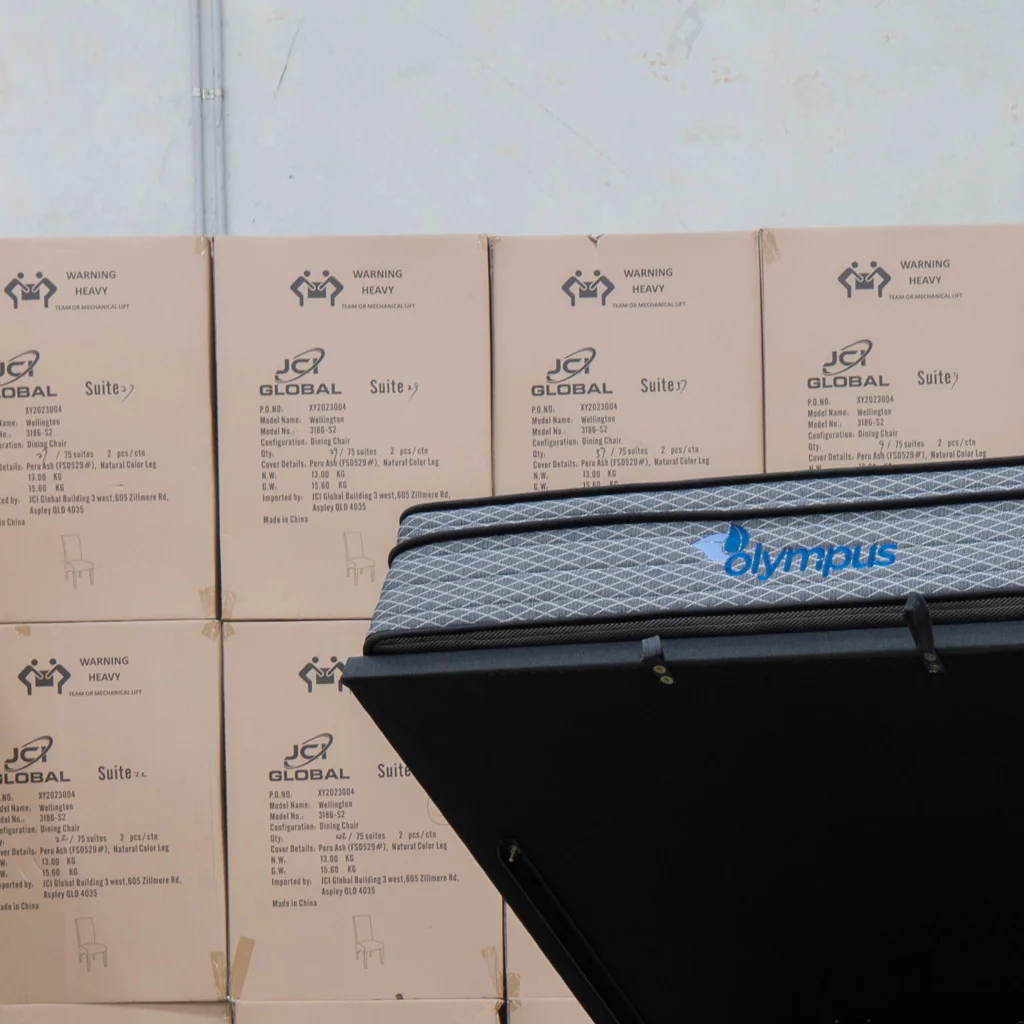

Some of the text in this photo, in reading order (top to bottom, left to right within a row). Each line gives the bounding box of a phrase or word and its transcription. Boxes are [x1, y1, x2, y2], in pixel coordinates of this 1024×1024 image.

[900, 260, 950, 269] WARNING
[66, 270, 116, 280] WARNING
[353, 269, 403, 279] WARNING
[623, 268, 673, 278] WARNING
[909, 275, 942, 285] HEAVY
[75, 286, 108, 296] HEAVY
[361, 285, 395, 294] HEAVY
[632, 284, 665, 293] HEAVY
[822, 345, 869, 370] JCI
[275, 353, 321, 378] JCI
[546, 353, 592, 378] JCI
[806, 375, 890, 389] GLOBAL
[917, 370, 951, 385] Suite
[85, 380, 119, 396] Suite
[259, 383, 342, 397] GLOBAL
[370, 379, 403, 394] Suite
[530, 382, 613, 397] GLOBAL
[640, 378, 674, 393] Suite
[581, 403, 618, 412] XY2023004
[857, 408, 892, 417] Wellington
[310, 416, 345, 425] Wellington
[581, 415, 615, 424] Wellington
[858, 429, 898, 439] Dining Chair
[311, 437, 350, 446] Dining Chair
[582, 437, 622, 446] Dining Chair
[263, 516, 280, 524] Made
[289, 515, 308, 523] China
[79, 657, 129, 666] WARNING
[88, 672, 122, 681] HEAVY
[3, 742, 50, 766] JCI
[283, 739, 329, 764] JCI
[98, 765, 132, 780] Suite
[268, 768, 350, 782] GLOBAL
[377, 763, 411, 778] Suite
[38, 791, 75, 800] XY2023004
[318, 788, 355, 797] XY2023004
[39, 803, 74, 812] Wellington
[319, 800, 353, 810] Wellington
[39, 824, 80, 834] Dining Chair
[320, 822, 359, 831] Dining Chair
[113, 845, 138, 853] Natural
[158, 844, 169, 853] Leg
[391, 843, 416, 851] Natural
[437, 842, 448, 851] Leg
[321, 888, 343, 897] Aspley
[273, 899, 289, 907] Made
[298, 899, 317, 907] China
